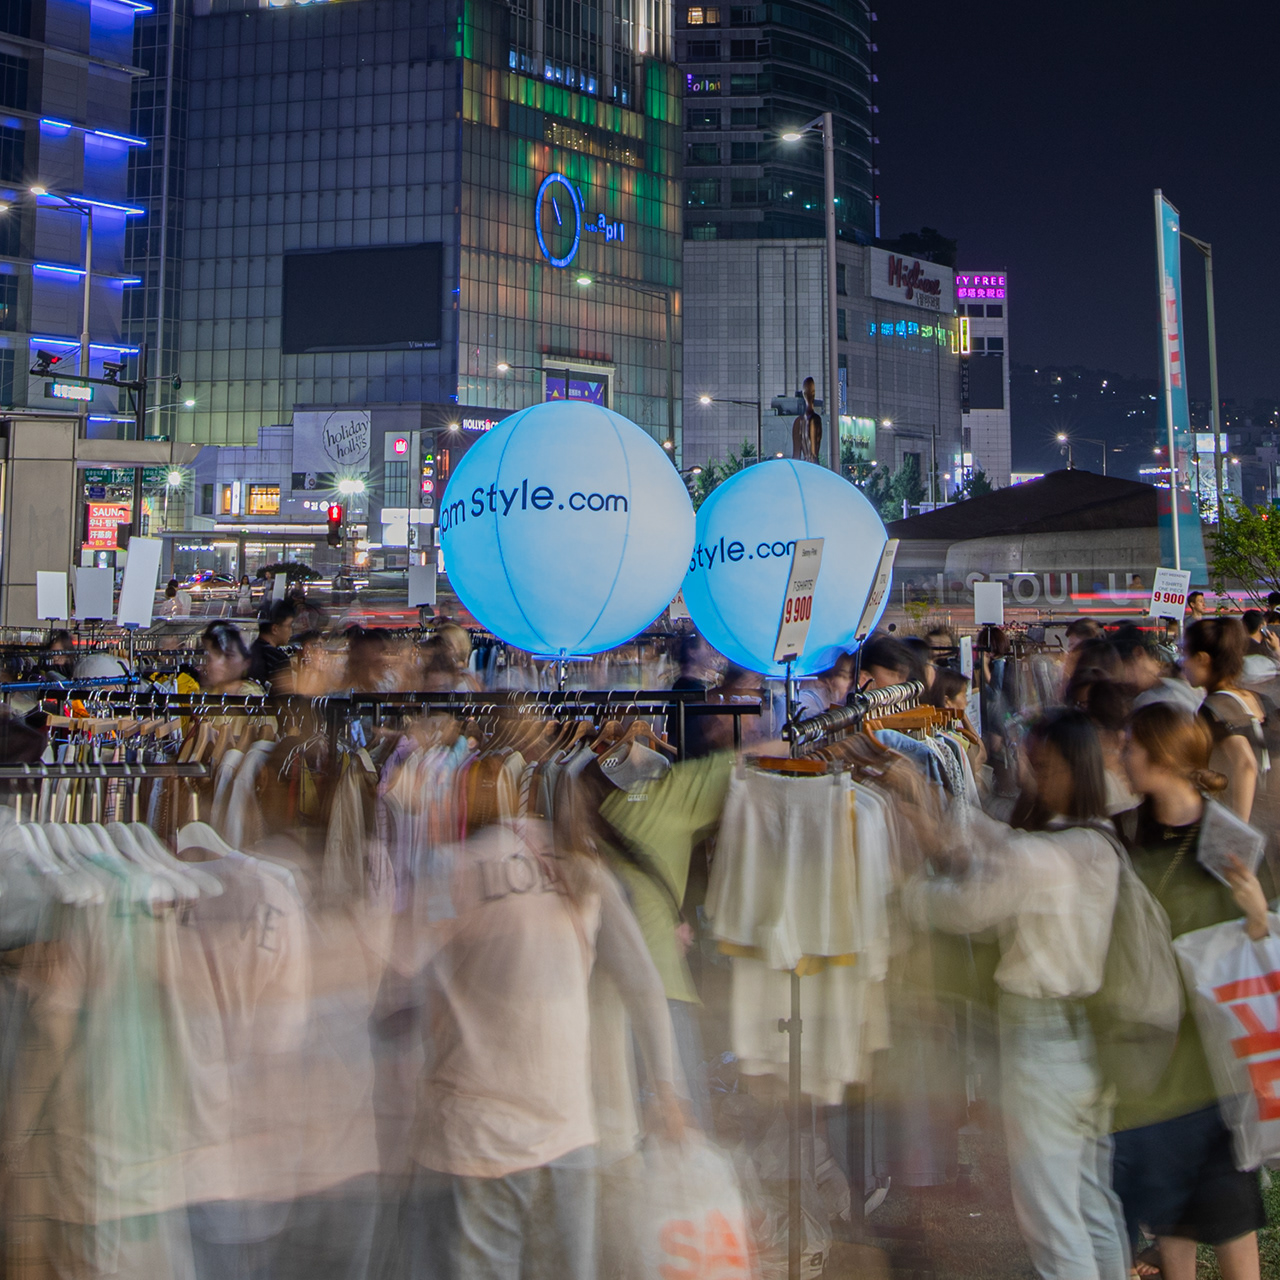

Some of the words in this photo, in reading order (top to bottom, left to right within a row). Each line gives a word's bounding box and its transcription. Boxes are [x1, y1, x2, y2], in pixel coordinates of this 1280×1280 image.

[974, 276, 1005, 286] FREE
[463, 419, 485, 431] HOLLYS
[326, 420, 368, 447] holiday
[93, 507, 124, 517] SAUNA
[439, 499, 466, 541] pm
[470, 478, 628, 519] Style.com
